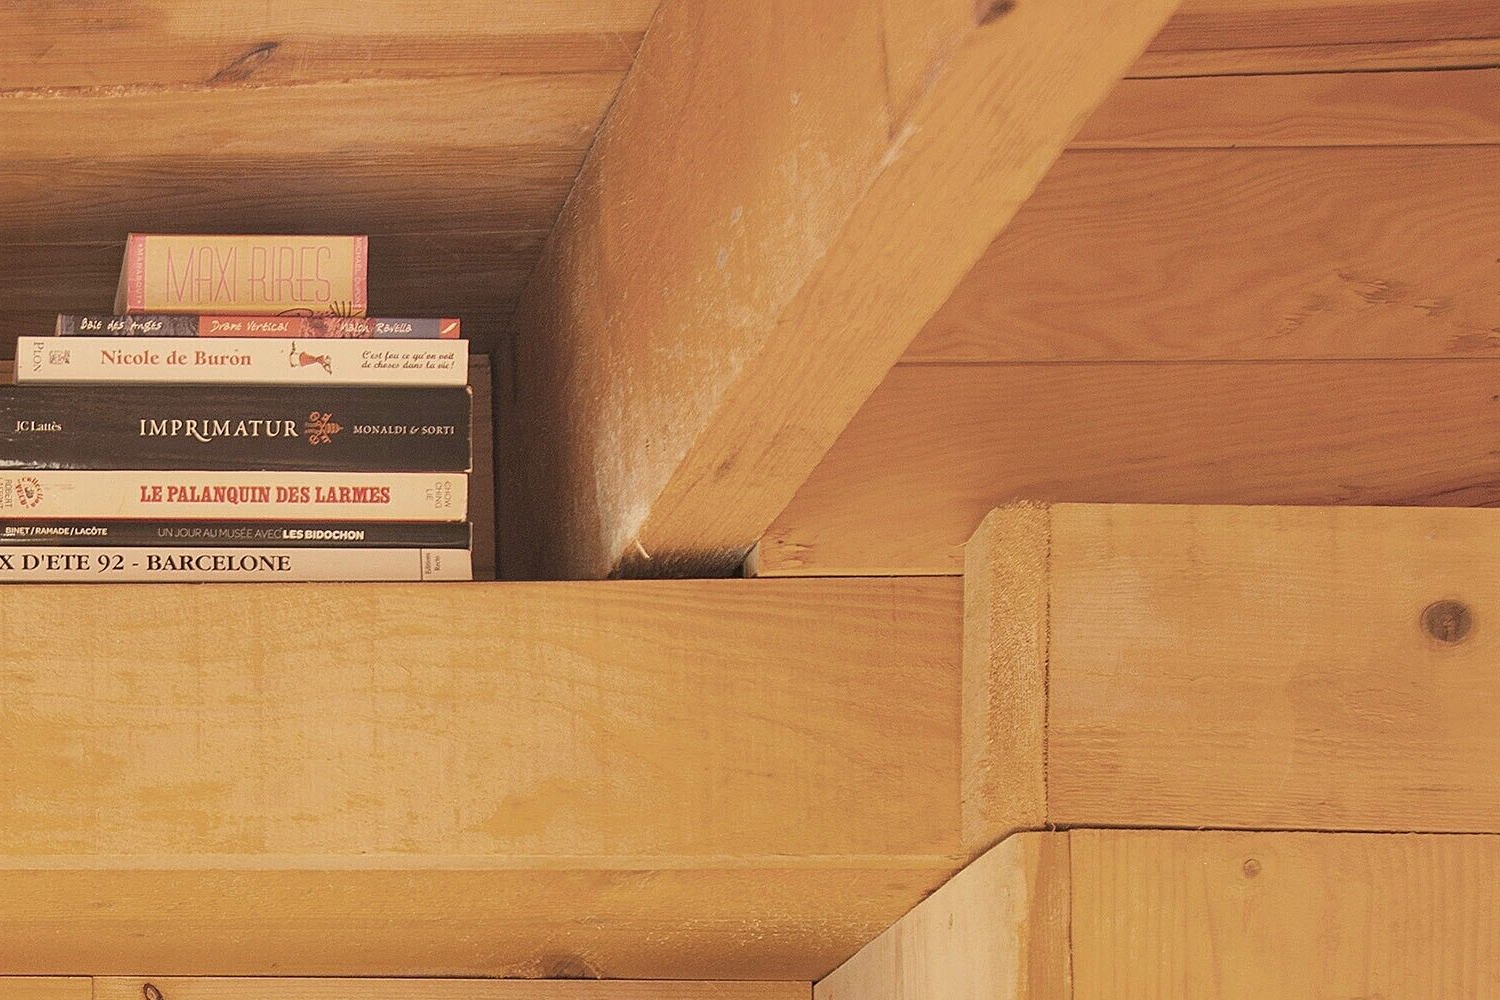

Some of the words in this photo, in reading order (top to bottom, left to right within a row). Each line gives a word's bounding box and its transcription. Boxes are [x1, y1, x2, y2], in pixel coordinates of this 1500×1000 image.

[166, 247, 237, 302] MAXI
[249, 246, 331, 302] RIRES
[101, 350, 160, 365] Nicole
[167, 351, 188, 365] de
[195, 350, 252, 365] Buron
[140, 419, 299, 440] IMPRIMATUR
[353, 426, 407, 434] MONALDI
[422, 426, 454, 435] SORTI
[140, 486, 162, 503] LE
[167, 486, 271, 505] PALANQUIN
[276, 486, 310, 503] DES
[315, 487, 391, 504] LARMES
[158, 528, 173, 537] UN
[175, 528, 201, 537] JOUR
[203, 529, 218, 537] AU
[220, 526, 251, 537] MUSÉE
[254, 529, 281, 539] AVEC
[283, 530, 304, 539] LES
[305, 530, 364, 540] BIDOCHON
[22, 555, 90, 570] D'ETE
[98, 555, 125, 572] 92
[147, 555, 291, 571] BARCELONE
